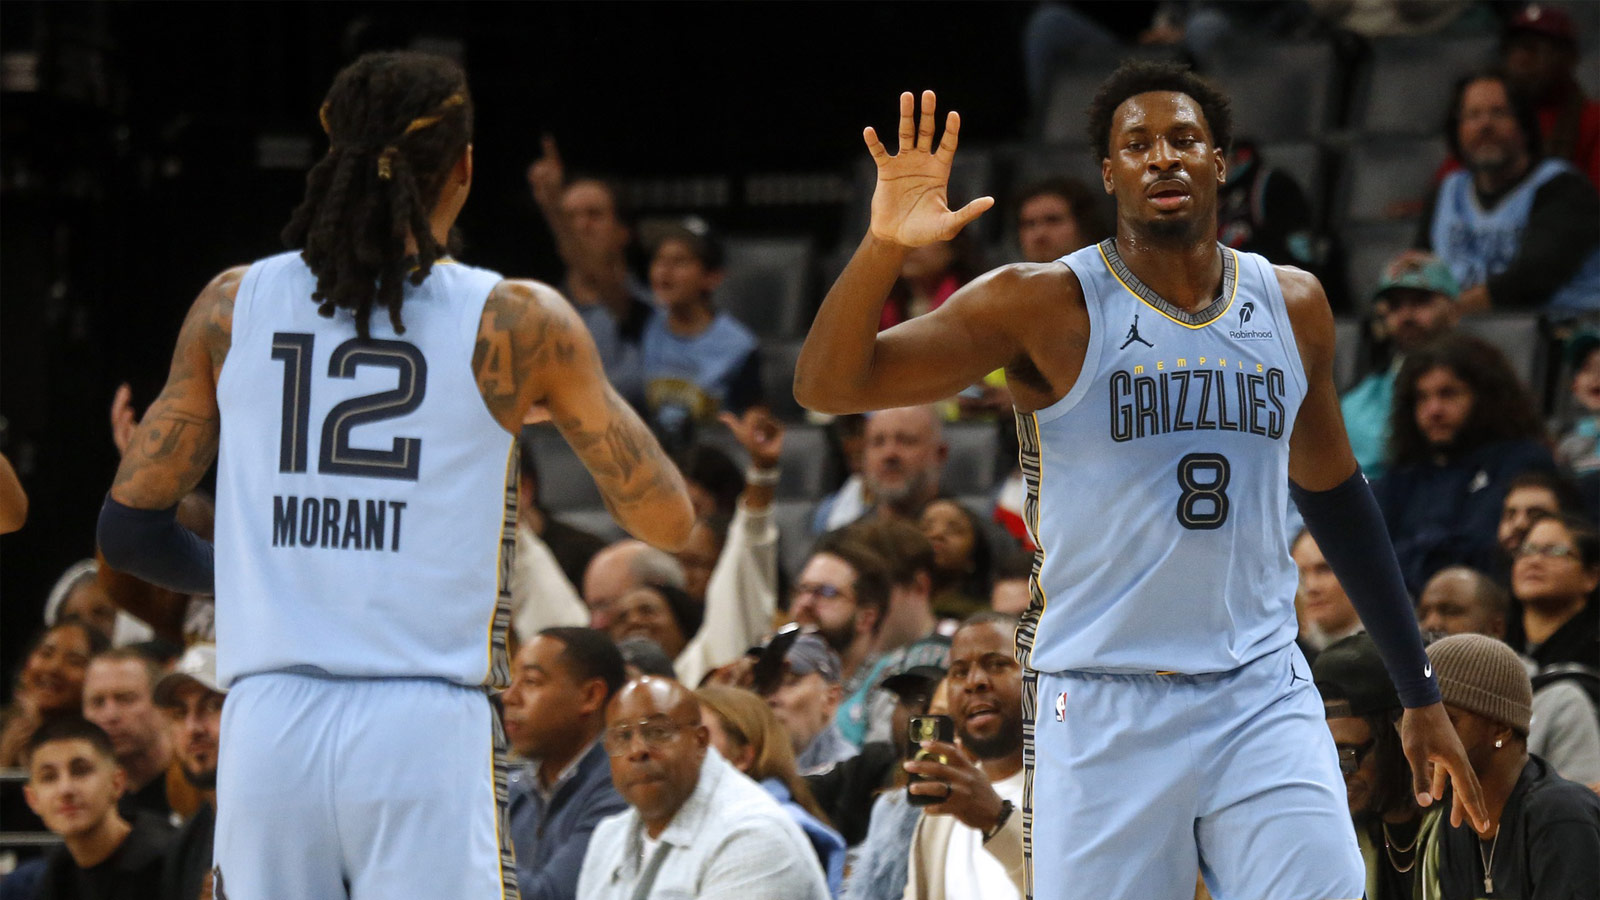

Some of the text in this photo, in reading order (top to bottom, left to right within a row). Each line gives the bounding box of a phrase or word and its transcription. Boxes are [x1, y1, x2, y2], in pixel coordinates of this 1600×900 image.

[1134, 357, 1263, 374] MEMPHIS
[1229, 330, 1273, 339] Robinhood
[271, 332, 428, 482] 12
[1109, 367, 1286, 443] GRIZZLIES
[272, 495, 407, 552] MORANT
[1176, 452, 1231, 530] 8
